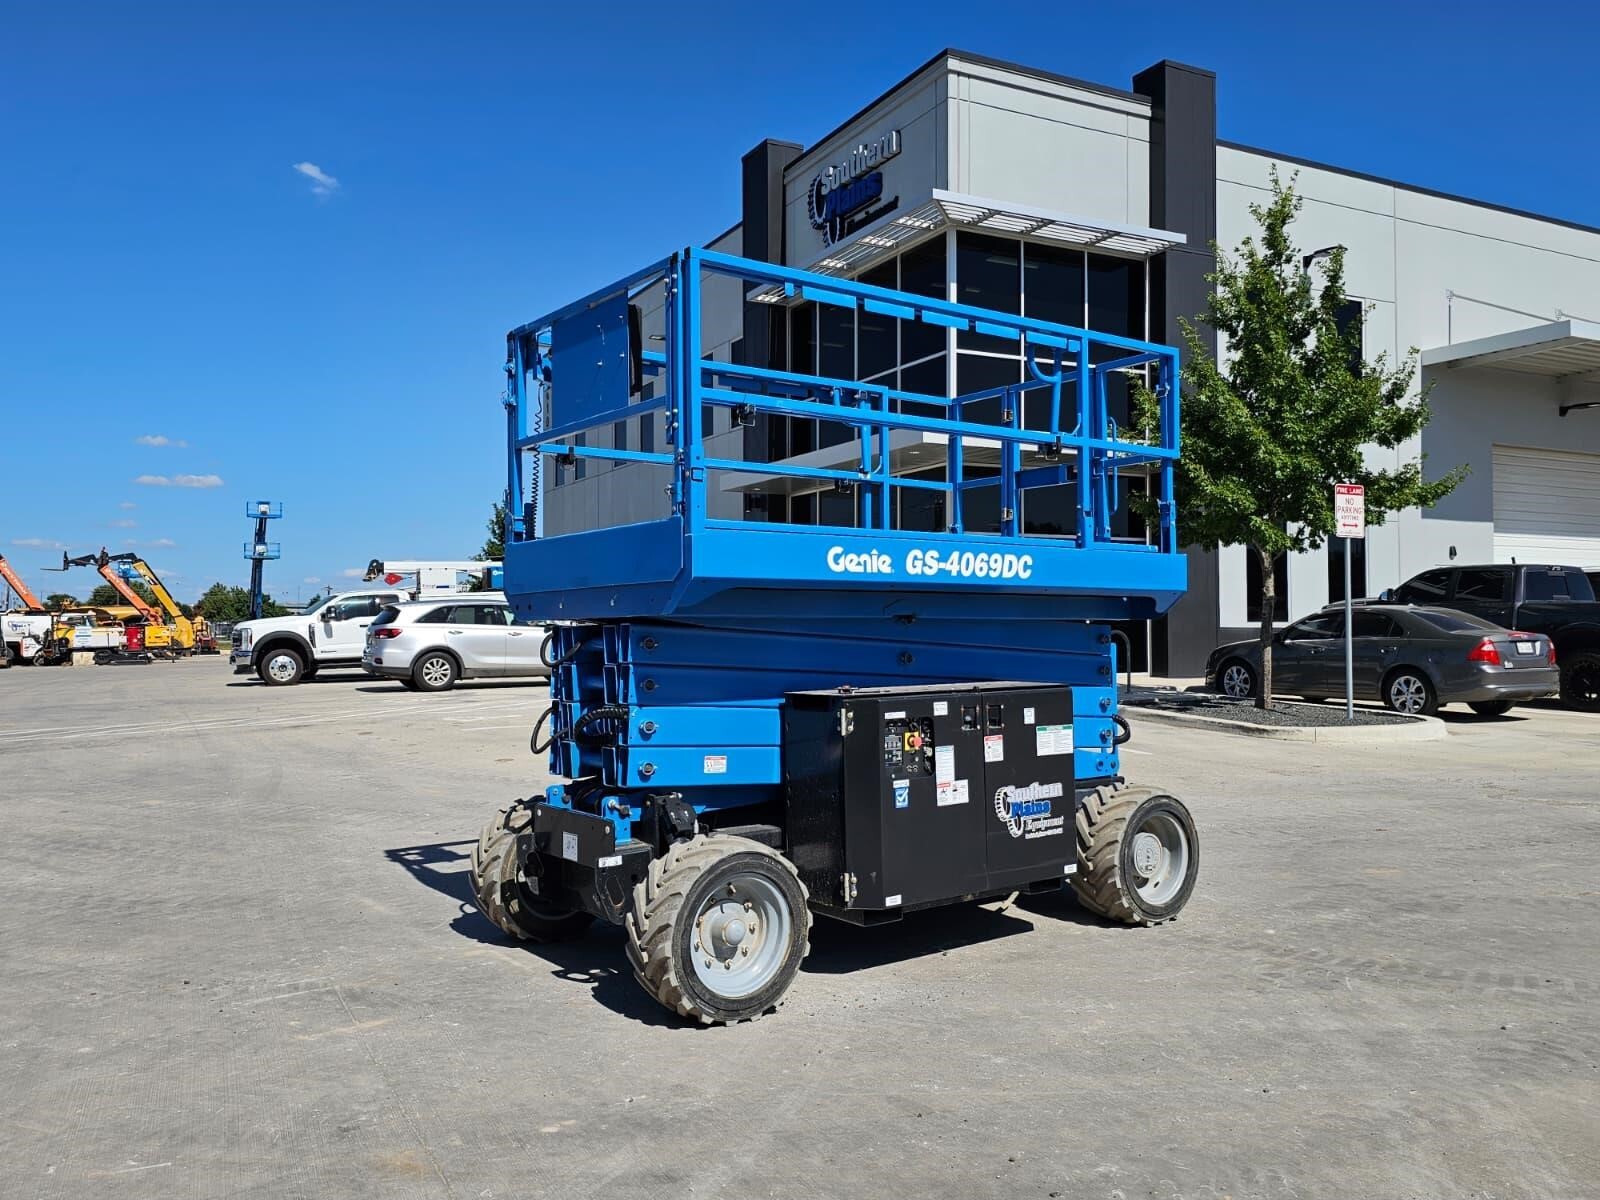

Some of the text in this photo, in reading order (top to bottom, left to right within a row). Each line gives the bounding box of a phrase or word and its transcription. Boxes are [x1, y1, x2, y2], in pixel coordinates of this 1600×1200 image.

[820, 129, 902, 196] Southern
[1337, 505, 1363, 515] PARKING
[1344, 497, 1355, 506] NO
[827, 546, 1033, 580] Genie GS-4069DC
[1006, 782, 1063, 803] Southern
[1010, 800, 1051, 819] Plains
